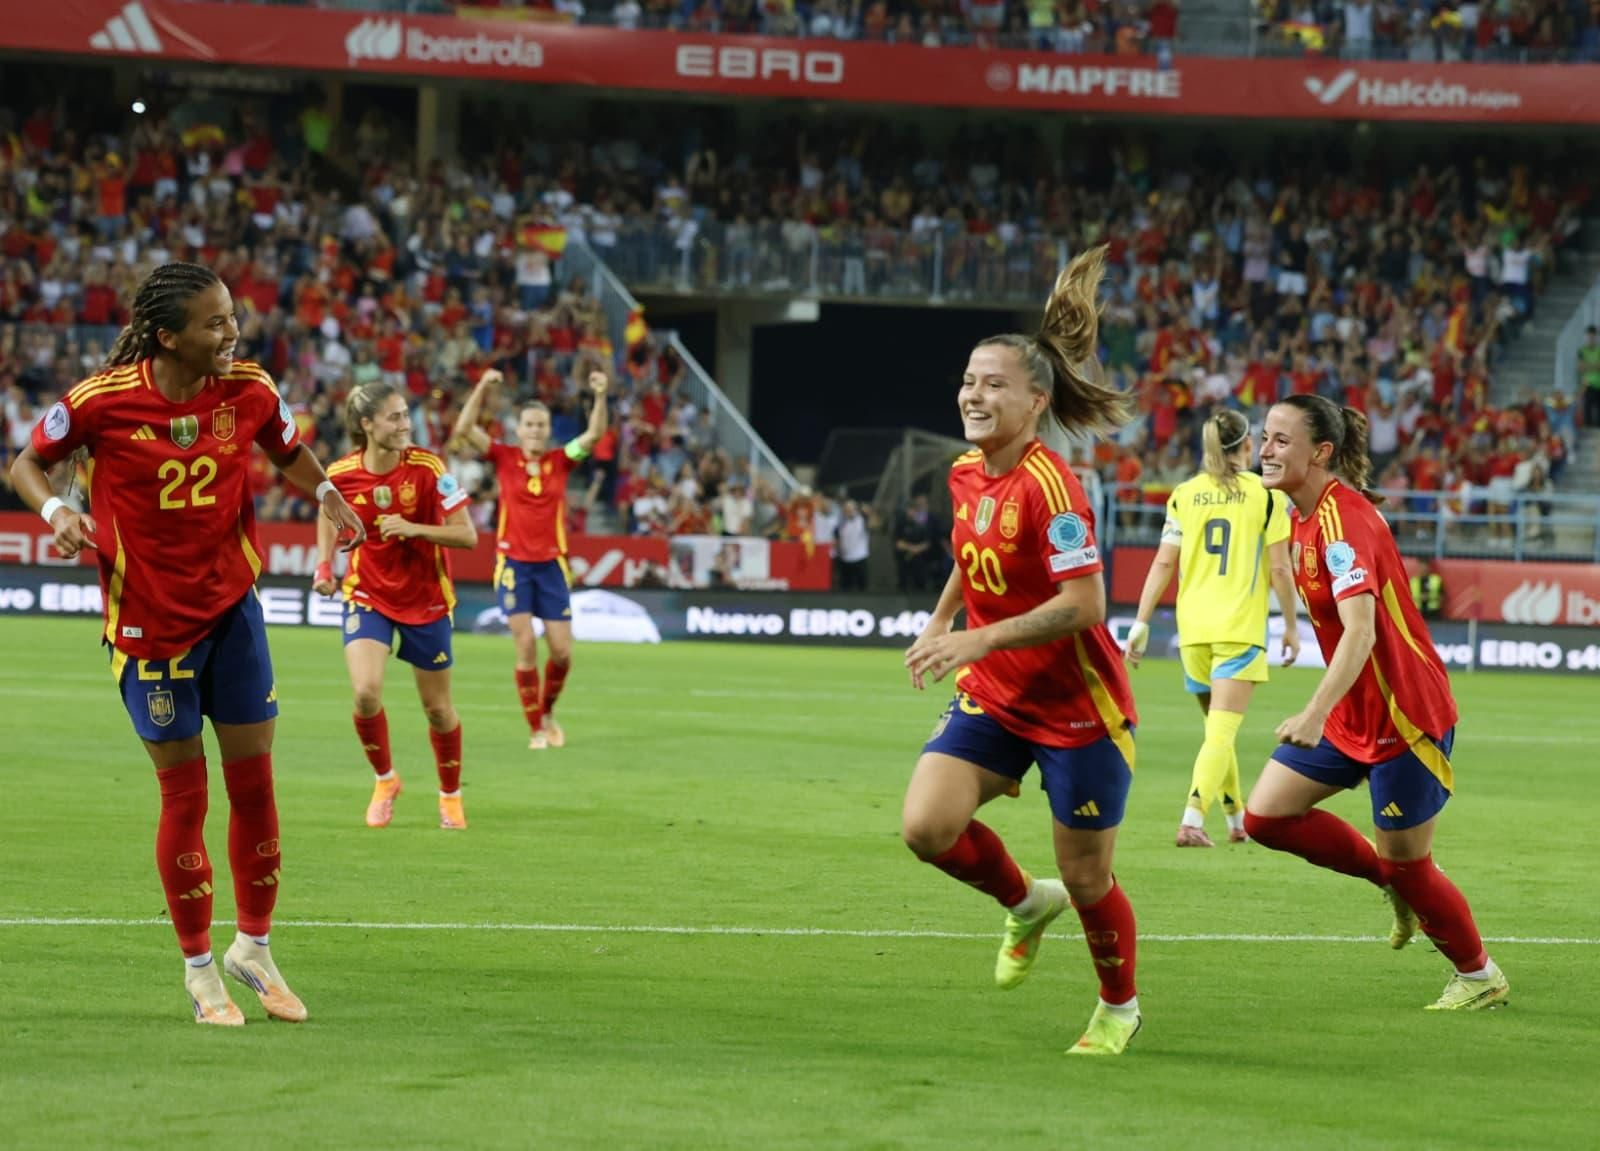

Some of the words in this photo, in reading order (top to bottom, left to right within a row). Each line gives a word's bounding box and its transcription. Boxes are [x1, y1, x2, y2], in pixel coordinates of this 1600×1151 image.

[406, 27, 544, 68] Iberdrola
[676, 45, 844, 84] EBRO
[1017, 63, 1182, 98] MAPFRE
[1358, 77, 1468, 107] Halcón
[158, 456, 218, 510] 22
[1205, 518, 1231, 576] 9
[961, 541, 1007, 596] 20
[0, 587, 35, 610] vo
[40, 583, 104, 613] EBR
[685, 605, 784, 635] Nuevo
[789, 608, 875, 637] EBRO
[878, 609, 937, 638] s40
[1434, 642, 1474, 665] vo
[1480, 638, 1562, 669] EBRO
[1566, 643, 1600, 670] s4
